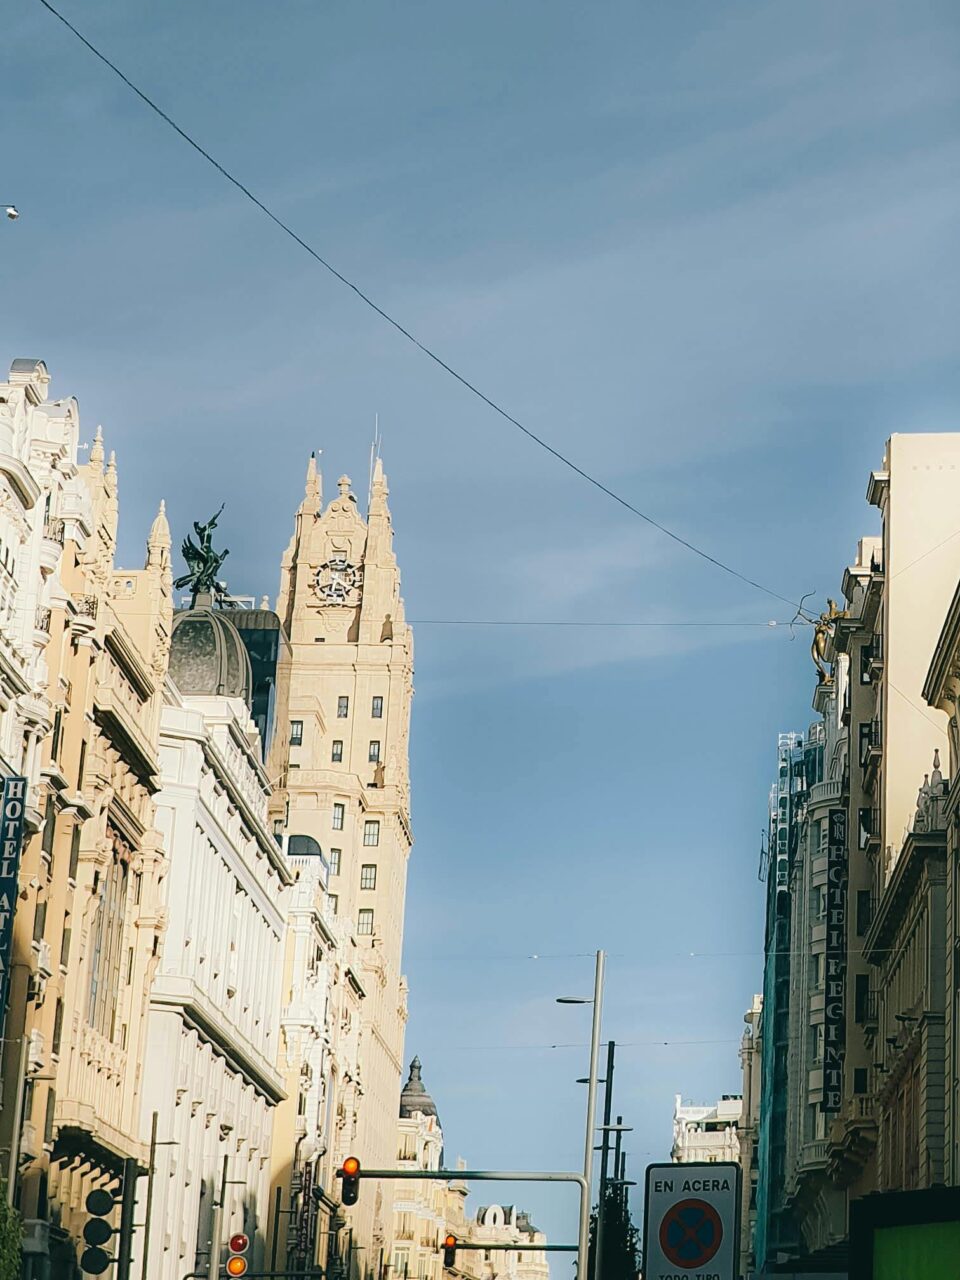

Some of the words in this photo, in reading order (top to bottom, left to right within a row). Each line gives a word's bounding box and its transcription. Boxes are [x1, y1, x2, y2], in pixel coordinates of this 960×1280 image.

[0, 781, 24, 878] HOTEL
[654, 1181, 674, 1193] EN
[682, 1180, 730, 1192] ACERA
